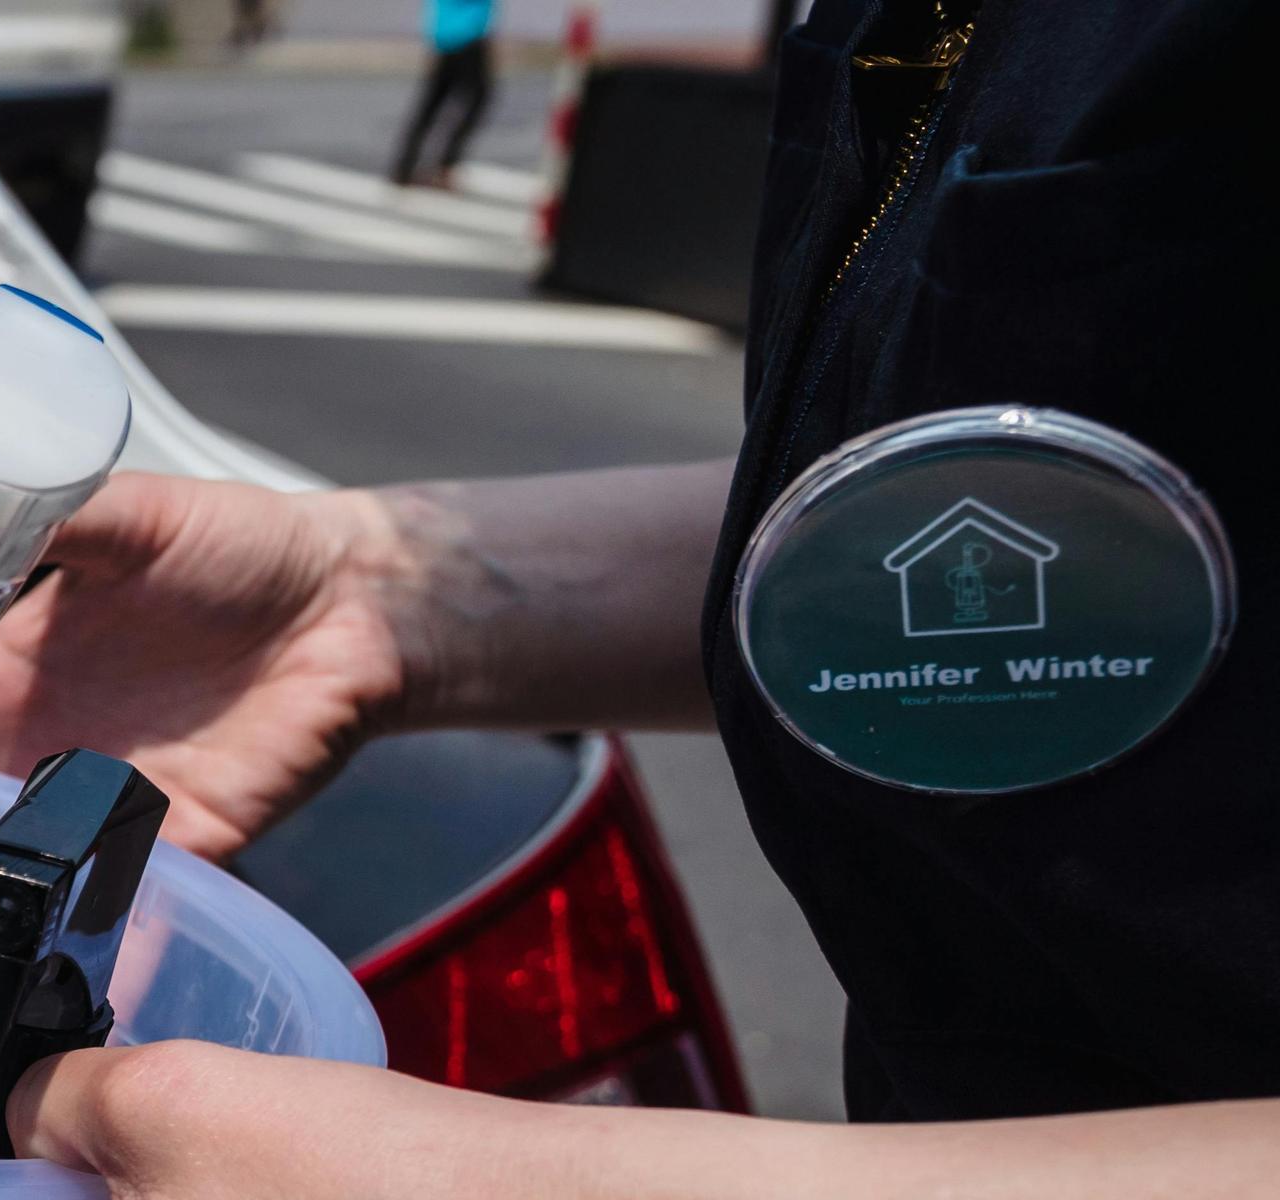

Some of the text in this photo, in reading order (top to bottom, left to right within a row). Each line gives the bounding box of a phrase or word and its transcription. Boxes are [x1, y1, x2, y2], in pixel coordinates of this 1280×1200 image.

[808, 654, 1154, 693] Jennifer Winter
[898, 690, 1058, 706] Your Profession Here
